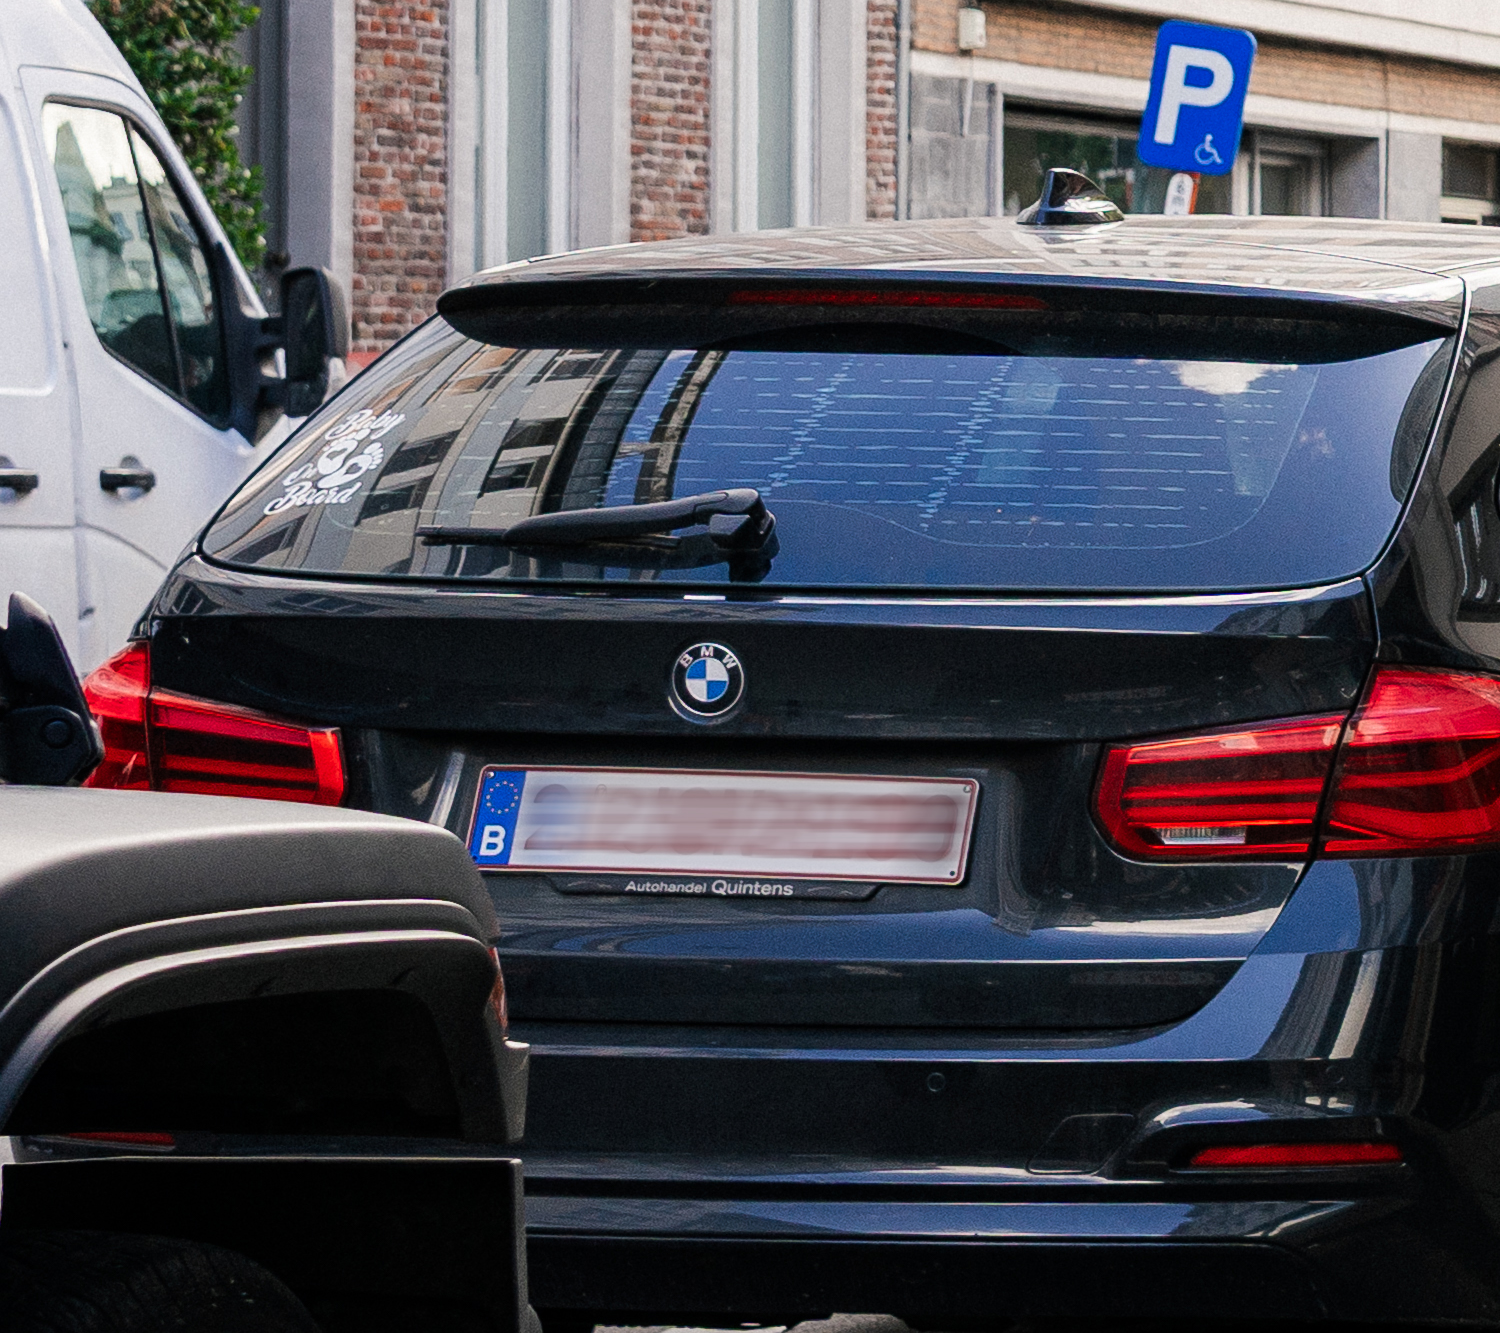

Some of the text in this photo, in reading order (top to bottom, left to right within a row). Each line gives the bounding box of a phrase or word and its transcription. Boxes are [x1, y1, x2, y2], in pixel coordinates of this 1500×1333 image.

[1153, 44, 1235, 146] P
[325, 409, 406, 440] Baby
[263, 481, 362, 515] Board
[680, 646, 737, 669] BMW
[479, 824, 506, 856] B
[625, 879, 794, 897] Autohandel Quintens
